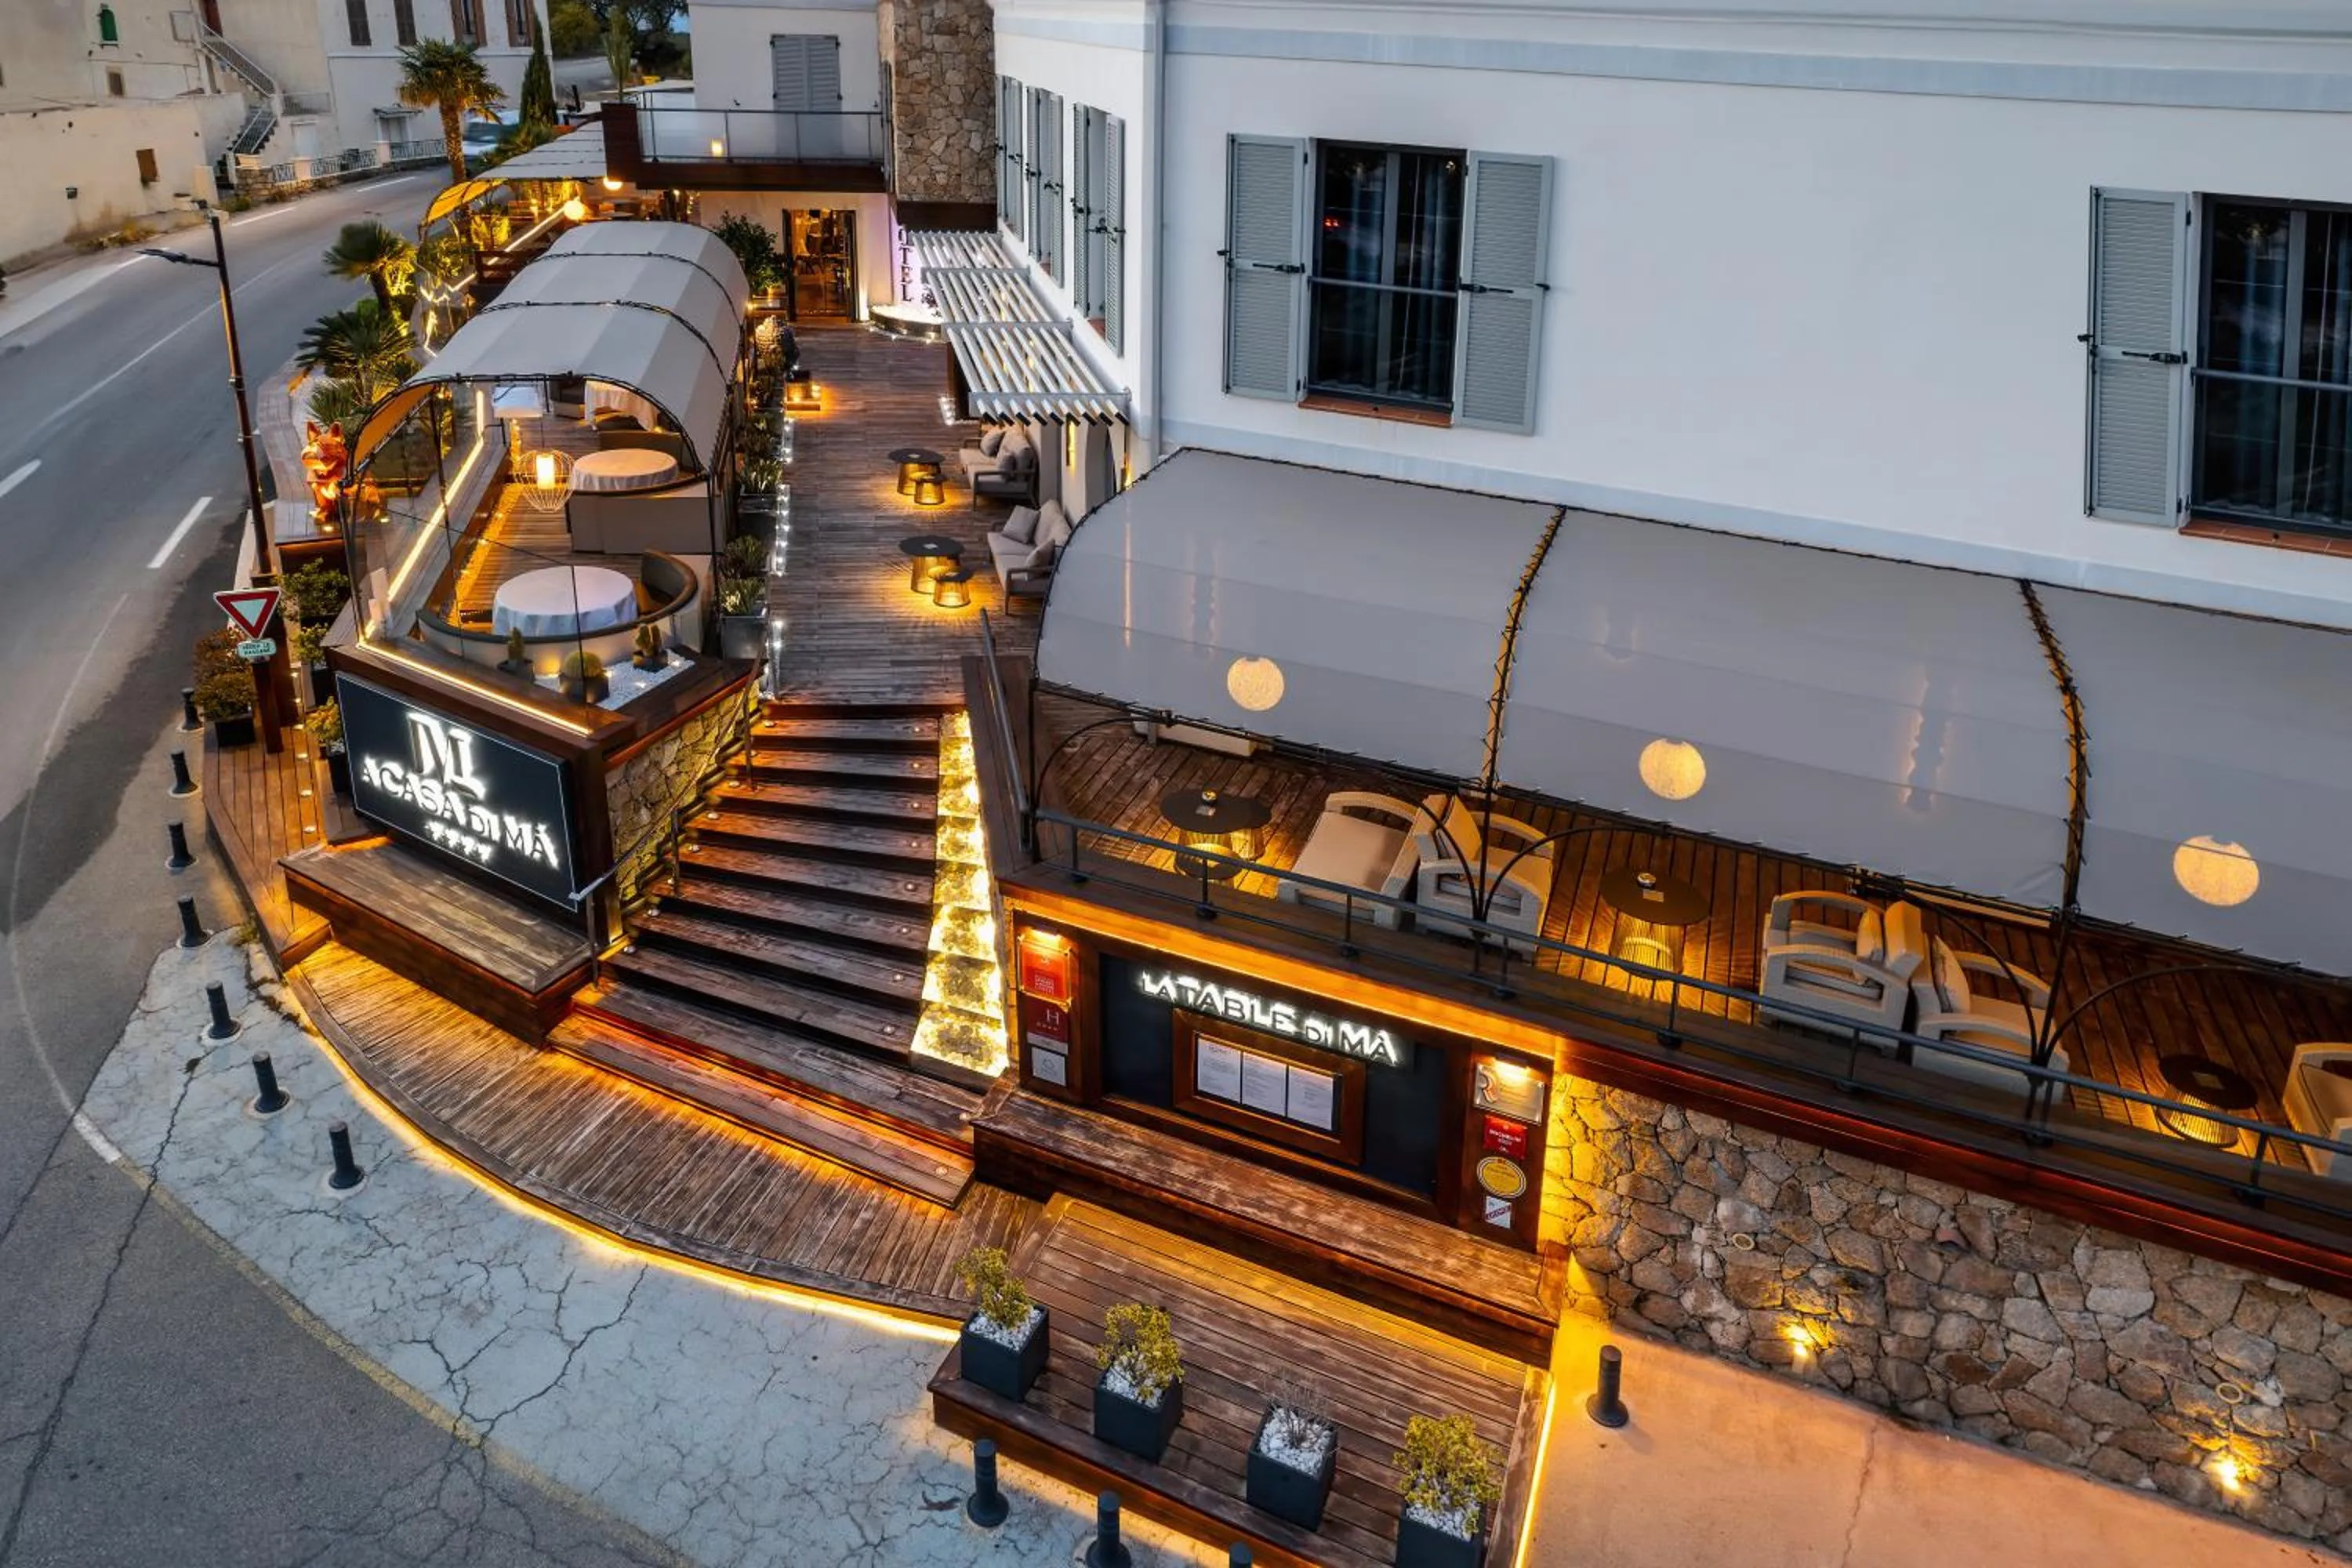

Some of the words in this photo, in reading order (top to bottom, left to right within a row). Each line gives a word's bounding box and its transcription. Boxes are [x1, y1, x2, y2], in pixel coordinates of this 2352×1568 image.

[898, 228, 913, 302] OTEL
[379, 760, 468, 828] CASA
[468, 804, 501, 843] DI
[1047, 1008, 1059, 1026] H
[1142, 971, 1176, 1003] LA
[1176, 975, 1299, 1036] TABLE
[1304, 1018, 1334, 1047] DI
